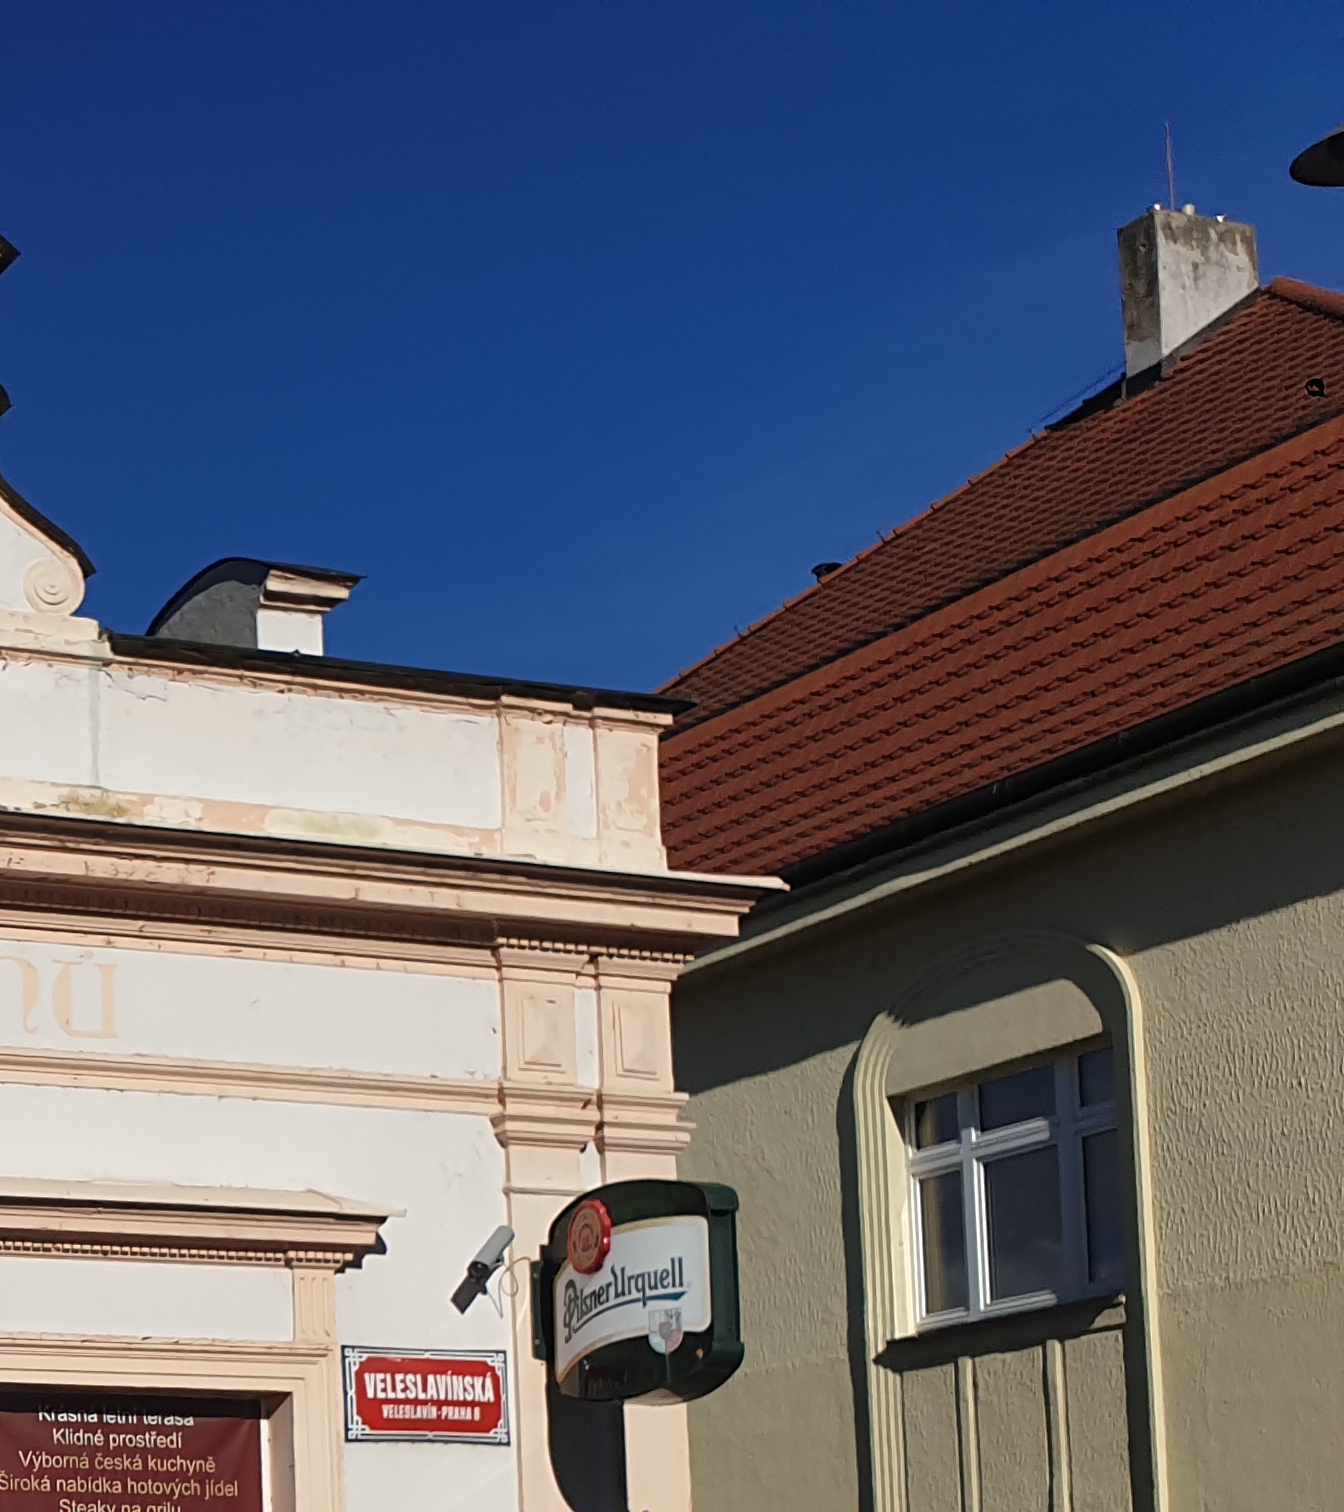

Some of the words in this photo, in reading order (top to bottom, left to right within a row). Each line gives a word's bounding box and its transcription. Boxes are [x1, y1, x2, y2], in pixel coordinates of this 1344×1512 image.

[563, 1278, 613, 1344] Pilsner
[610, 1256, 685, 1309] Urquell
[364, 1370, 495, 1403] VELESLAVÍNSKÁ
[52, 1428, 104, 1446] Klidné
[109, 1430, 182, 1450] prostředí
[19, 1450, 89, 1472] Výborná
[95, 1453, 142, 1470] česká
[148, 1455, 216, 1476] kuchyně
[56, 1475, 122, 1493] nabídka
[128, 1478, 201, 1498] hotových
[205, 1480, 238, 1500] jídel
